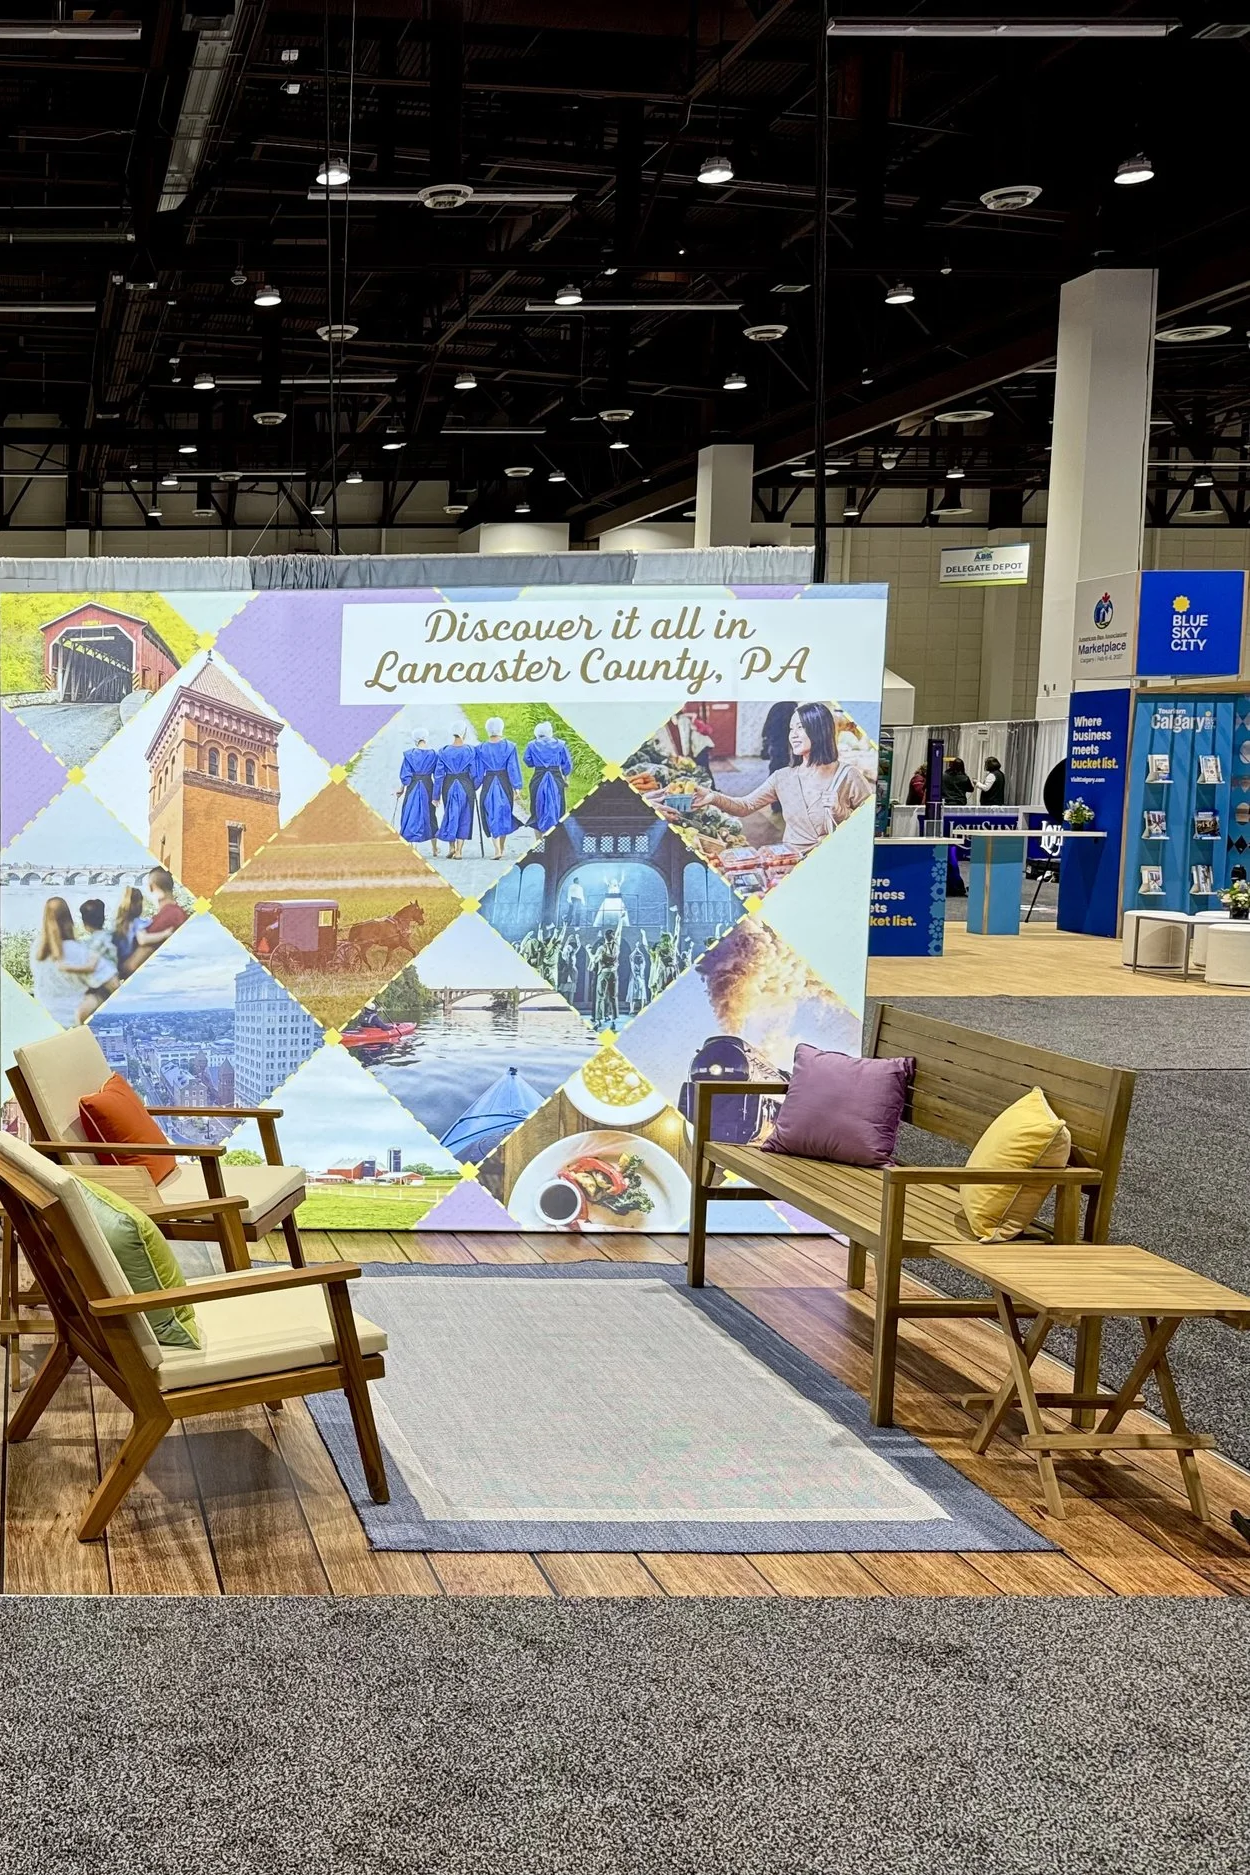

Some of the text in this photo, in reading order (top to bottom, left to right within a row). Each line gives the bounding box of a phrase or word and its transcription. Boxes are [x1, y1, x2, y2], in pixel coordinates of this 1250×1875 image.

[946, 562, 1022, 574] DELEGATE DEPOT
[424, 606, 756, 643] Discover it all in
[1173, 614, 1209, 627] BLUE
[1171, 627, 1202, 639] SKY
[1077, 641, 1127, 655] Marketplace
[1170, 638, 1207, 651] CITY
[364, 645, 811, 695] Lancaster County, PA
[1073, 716, 1102, 728] Where
[1151, 713, 1205, 733] Calgary
[1072, 729, 1111, 741] business
[1071, 743, 1100, 755] meets
[1071, 757, 1119, 770] bucket list.
[871, 878, 891, 887] ere
[870, 888, 906, 900] iness
[869, 914, 917, 927] ket list.
